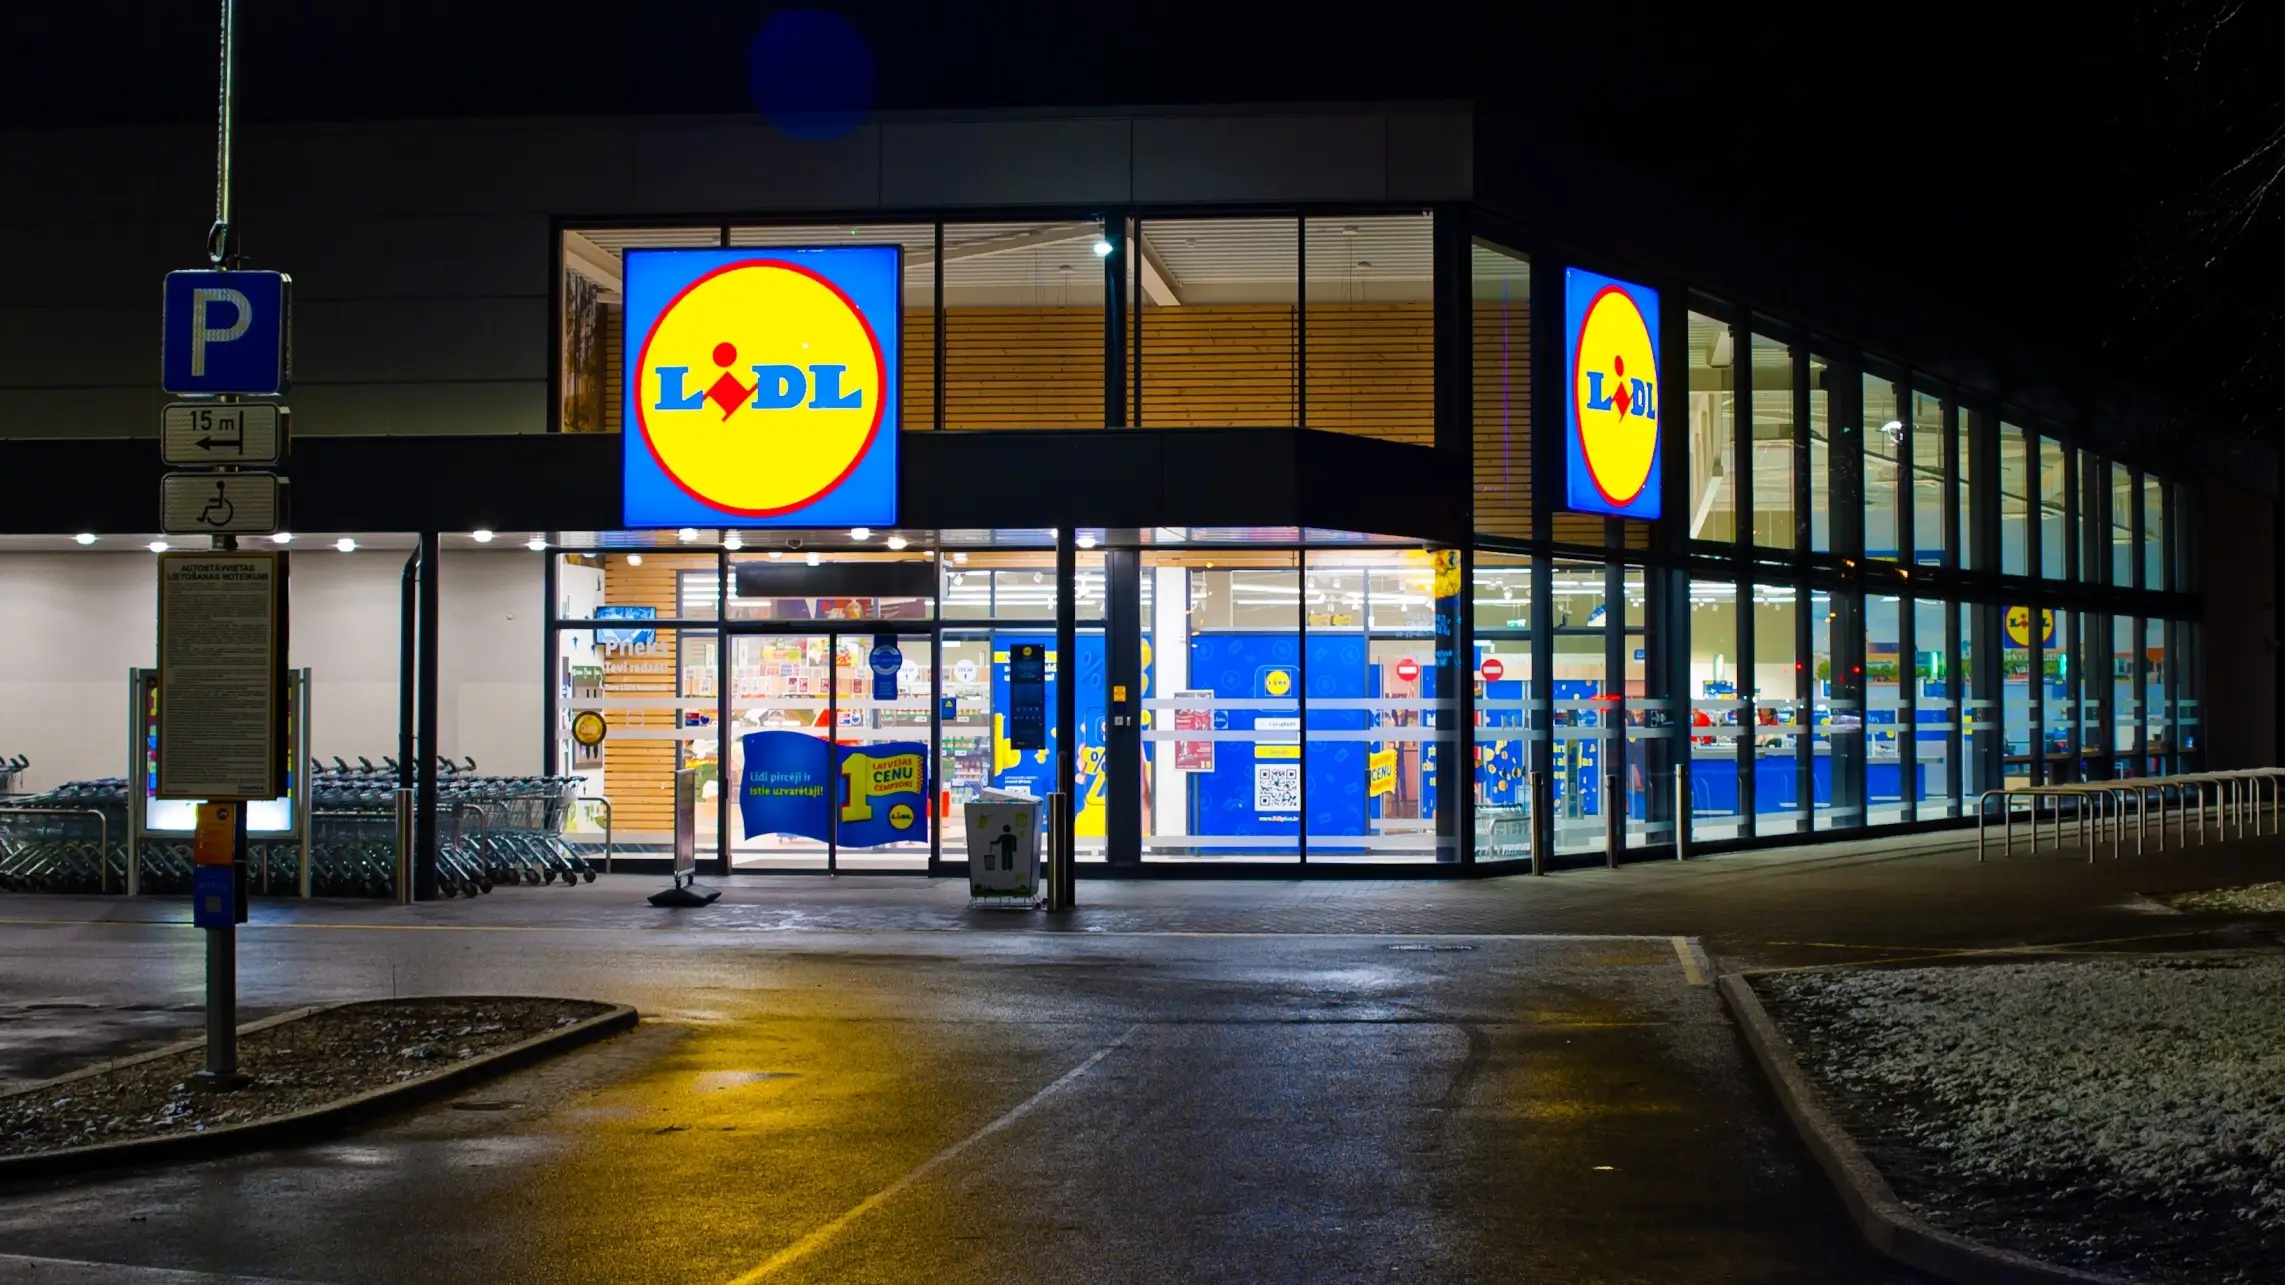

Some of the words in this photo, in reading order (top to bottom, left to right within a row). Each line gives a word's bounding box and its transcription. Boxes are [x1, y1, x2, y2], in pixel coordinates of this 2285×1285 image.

[191, 288, 253, 377] P
[655, 342, 863, 423] LIDL
[1586, 355, 1656, 422] LIDL
[190, 411, 212, 431] 15
[219, 418, 235, 431] m
[873, 758, 912, 770] LATVIJAS
[750, 772, 768, 781] Lidl
[771, 772, 801, 784] pircēji
[873, 767, 913, 783] CENU
